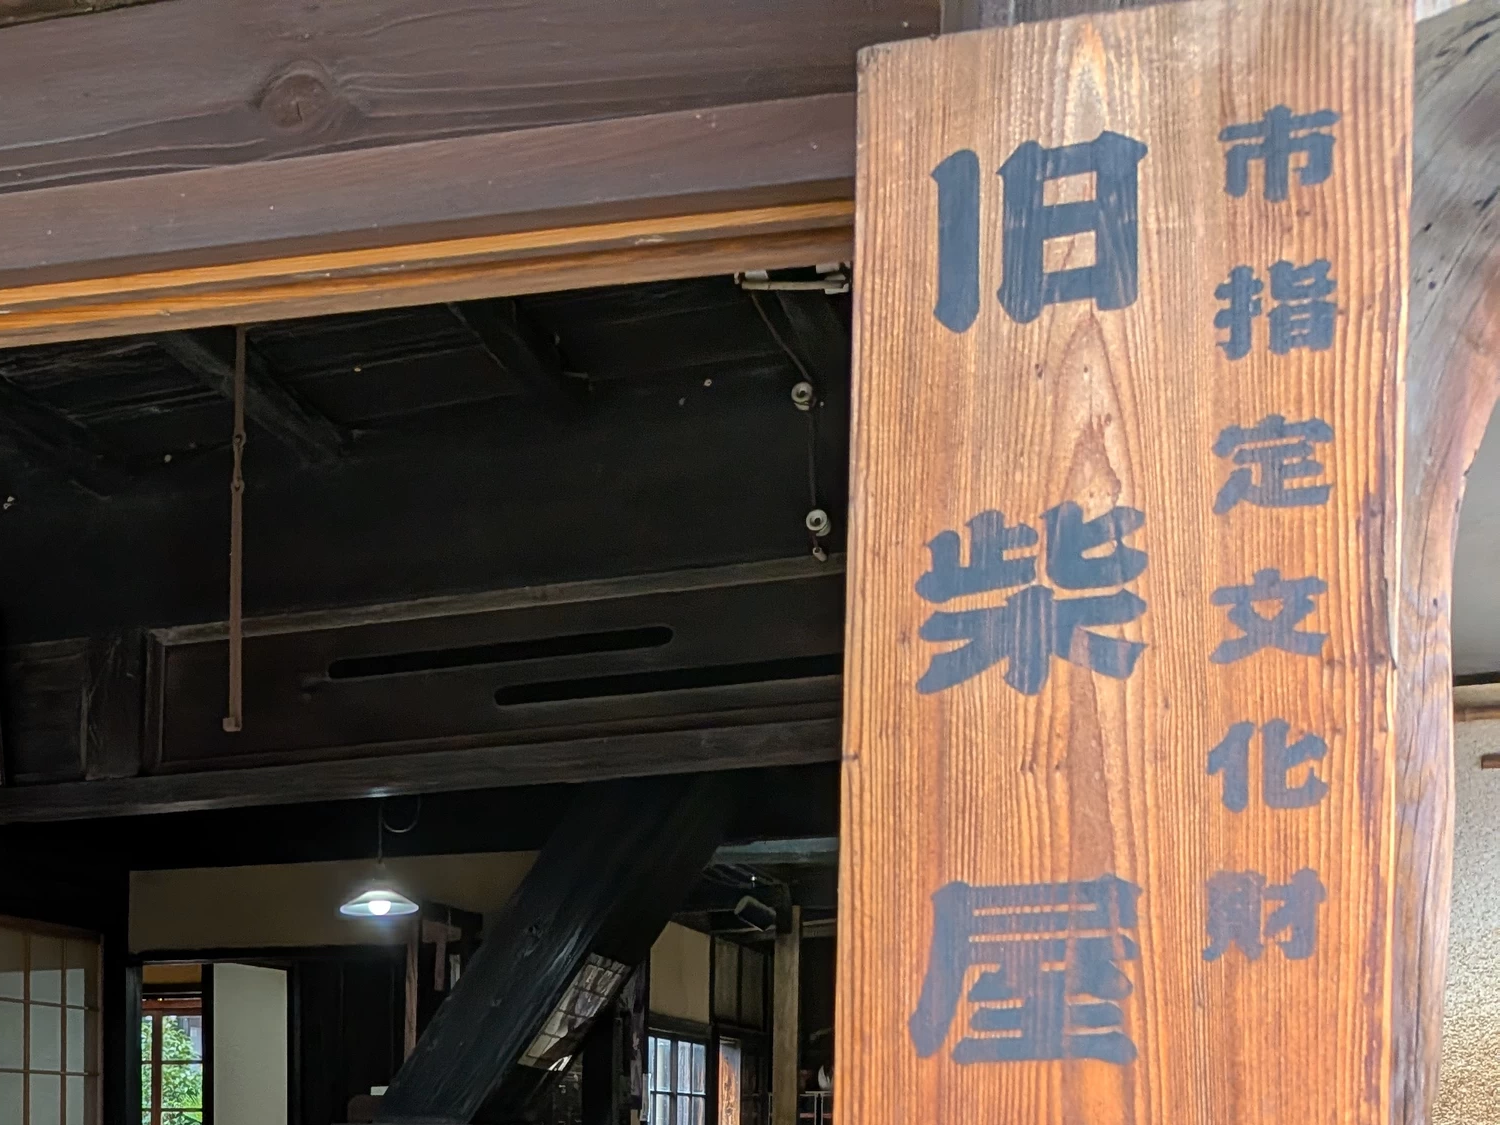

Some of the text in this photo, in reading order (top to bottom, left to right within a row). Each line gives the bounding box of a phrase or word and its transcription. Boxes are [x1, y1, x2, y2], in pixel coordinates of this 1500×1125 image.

[1202, 103, 1340, 961] 市指定文化財
